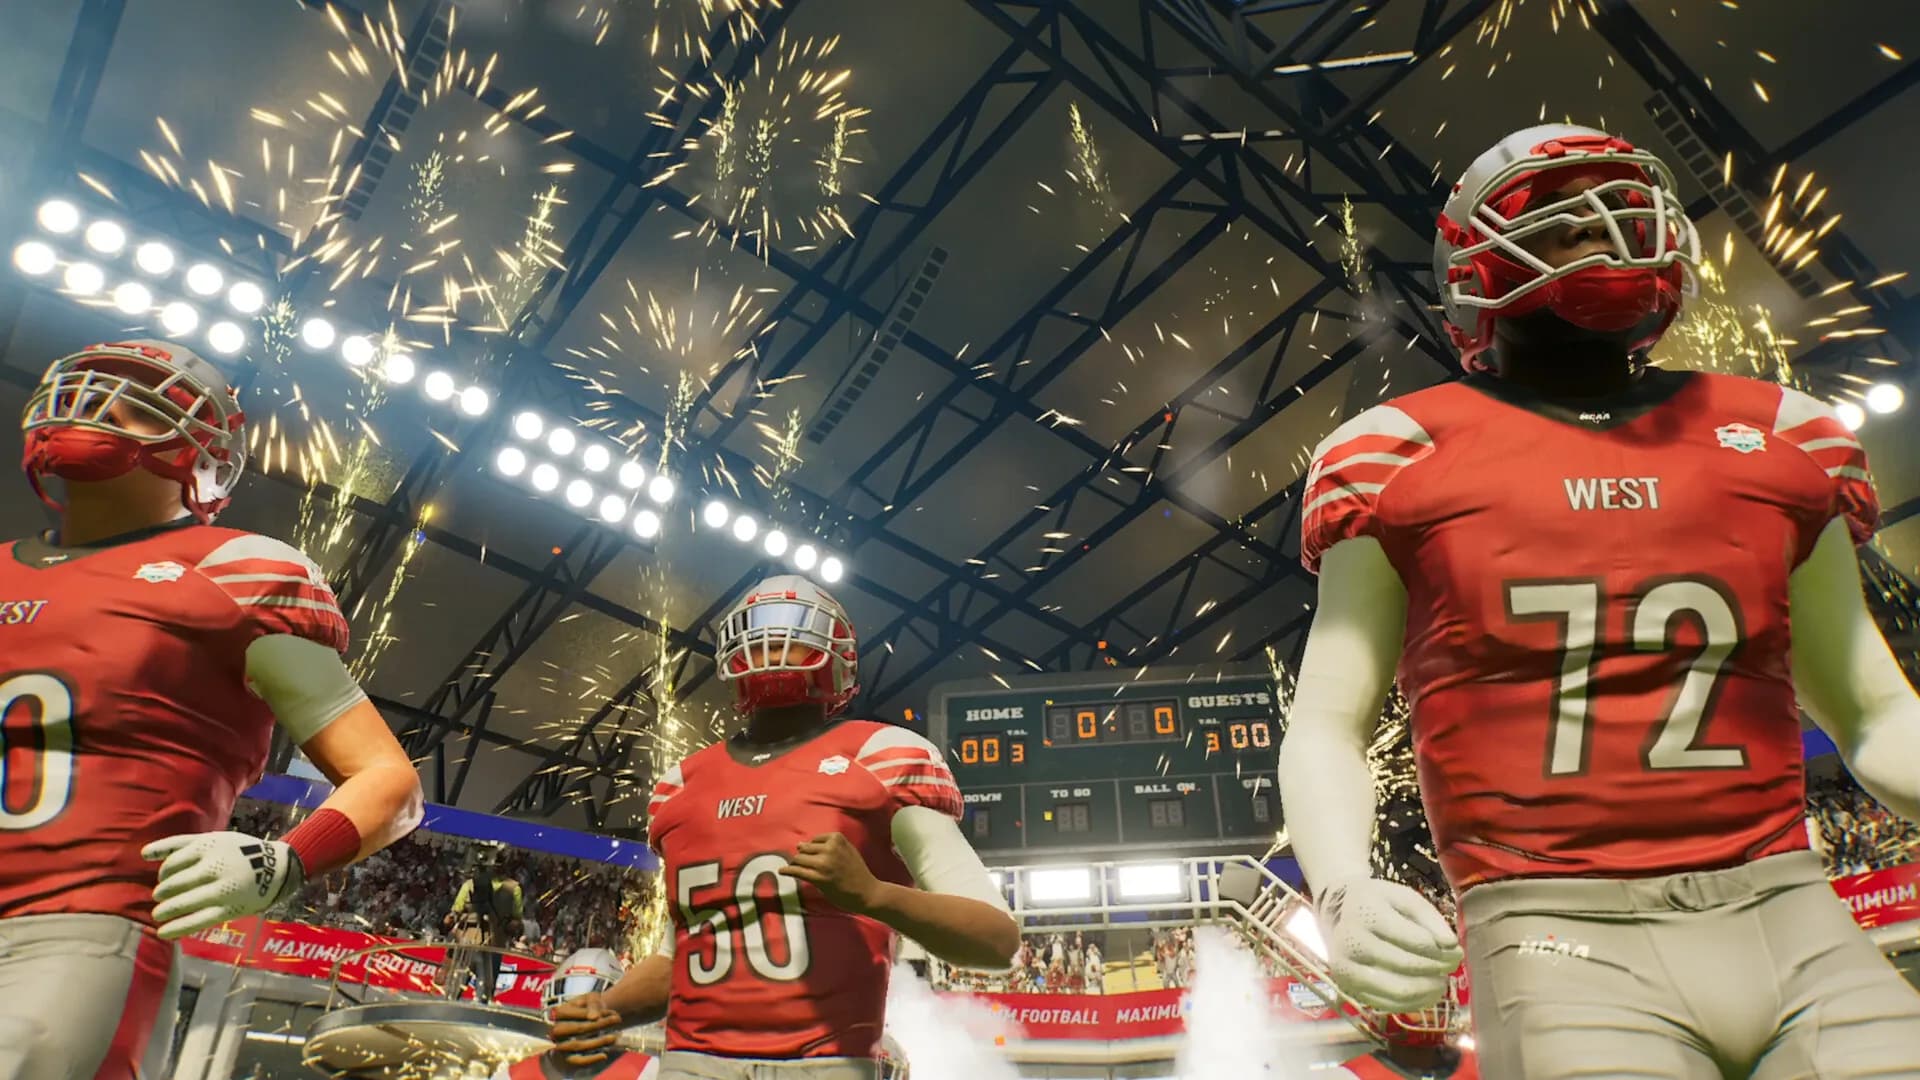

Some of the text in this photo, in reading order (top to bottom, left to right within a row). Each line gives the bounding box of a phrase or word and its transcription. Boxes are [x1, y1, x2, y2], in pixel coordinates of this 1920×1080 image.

[1563, 477, 1660, 511] WEST
[0, 600, 48, 624] EST
[1506, 578, 1747, 778] 72
[1188, 692, 1271, 709] GUESTS
[966, 707, 1025, 722] HOME
[1230, 722, 1271, 748] 00
[961, 738, 1000, 764] 00
[1011, 743, 1025, 763] 3
[963, 792, 1003, 804] DOWN
[1050, 788, 1092, 799] TO GO
[1134, 782, 1196, 795] BALL ON
[717, 795, 767, 820] WEST
[1843, 883, 1917, 913] XIMUM
[676, 854, 811, 986] 50
[263, 937, 437, 977] MAXIMUM FOOTBA
[1019, 1008, 1100, 1025] FOOTBALL
[1116, 1004, 1183, 1024] MAXIMU
